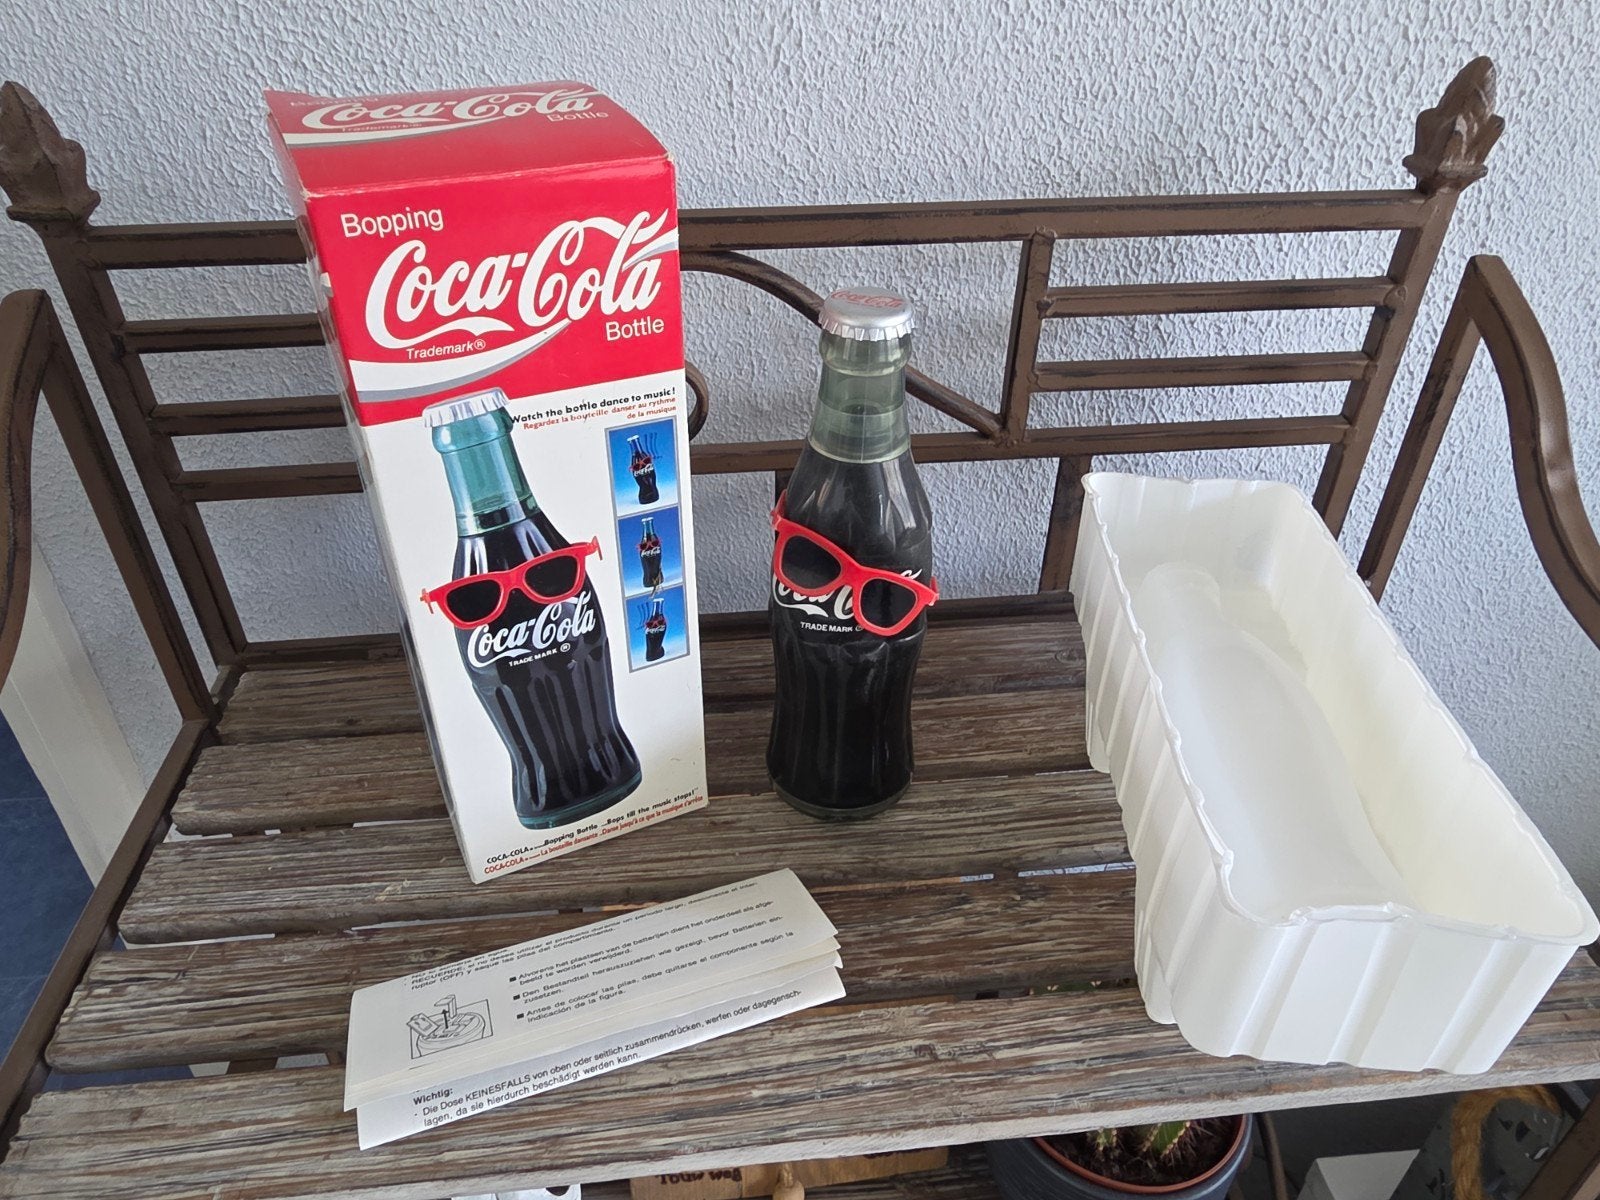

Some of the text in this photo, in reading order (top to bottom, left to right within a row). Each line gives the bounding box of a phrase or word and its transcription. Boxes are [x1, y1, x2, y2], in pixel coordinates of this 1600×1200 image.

[302, 87, 594, 130] Coca-Cola
[547, 110, 609, 123] Bottle
[340, 207, 444, 240] Bopping
[365, 208, 669, 349] Coca-Cola
[605, 316, 665, 342] Bottle
[511, 412, 543, 424] Watch
[545, 407, 563, 419] the
[565, 401, 598, 415] bottle
[600, 397, 630, 409] dance
[631, 394, 642, 402] to
[523, 418, 560, 431] Regardez
[611, 403, 636, 415] danser
[638, 401, 647, 409] au
[649, 396, 677, 408] rythme
[626, 412, 636, 420] de
[646, 406, 677, 419] musique
[467, 590, 596, 668] Coca-Cola
[800, 621, 854, 633] TRADE MARK
[508, 656, 534, 667] TRADE
[534, 648, 558, 660] MARK
[576, 824, 598, 835] Bottle
[626, 810, 636, 818] till
[638, 806, 650, 814] the
[652, 798, 672, 810] music
[518, 965, 555, 980] Alvorens
[555, 959, 569, 968] het
[570, 950, 605, 966] plaatsen
[605, 946, 621, 954] van
[621, 941, 632, 949] de
[632, 931, 670, 947] batterijen
[670, 924, 691, 934] dient
[690, 919, 704, 928] het
[704, 909, 742, 924] onderdeel
[521, 988, 540, 998] Den
[542, 973, 590, 991] Bestandteil
[591, 953, 656, 977] herauszuziehen
[657, 948, 672, 956] wie
[708, 931, 730, 941] bevor
[732, 919, 767, 934] Batterien
[411, 980, 437, 991] ruptor
[440, 971, 464, 982] (OFF)
[474, 961, 500, 973] saque
[538, 946, 551, 954] del
[519, 948, 633, 986] beeld te worden verwijderd.
[526, 1005, 552, 1017] Antes
[554, 1000, 566, 1009] de
[568, 990, 599, 1004] colocar
[601, 985, 615, 993] las
[641, 970, 663, 982] debe
[664, 959, 698, 975] quitarse
[709, 941, 758, 961] componente
[760, 934, 784, 946] según
[523, 988, 565, 1005] zusetzen.
[527, 988, 628, 1023] indicación de la figura.
[422, 1106, 439, 1117] Die
[440, 1096, 464, 1110] Dose
[465, 1073, 531, 1102] KEINESFALLS
[531, 1069, 549, 1080] von
[550, 1062, 572, 1075] oben
[573, 1055, 593, 1068] oder
[594, 1045, 624, 1060] seitlich
[624, 1021, 705, 1052] zusammendrücken,
[705, 1011, 733, 1026] werfen
[733, 1004, 751, 1017] oder
[412, 1086, 454, 1106] Wichtig:
[423, 1051, 642, 1128] lagen, da sie hierdurch beschädigt werden kann.
